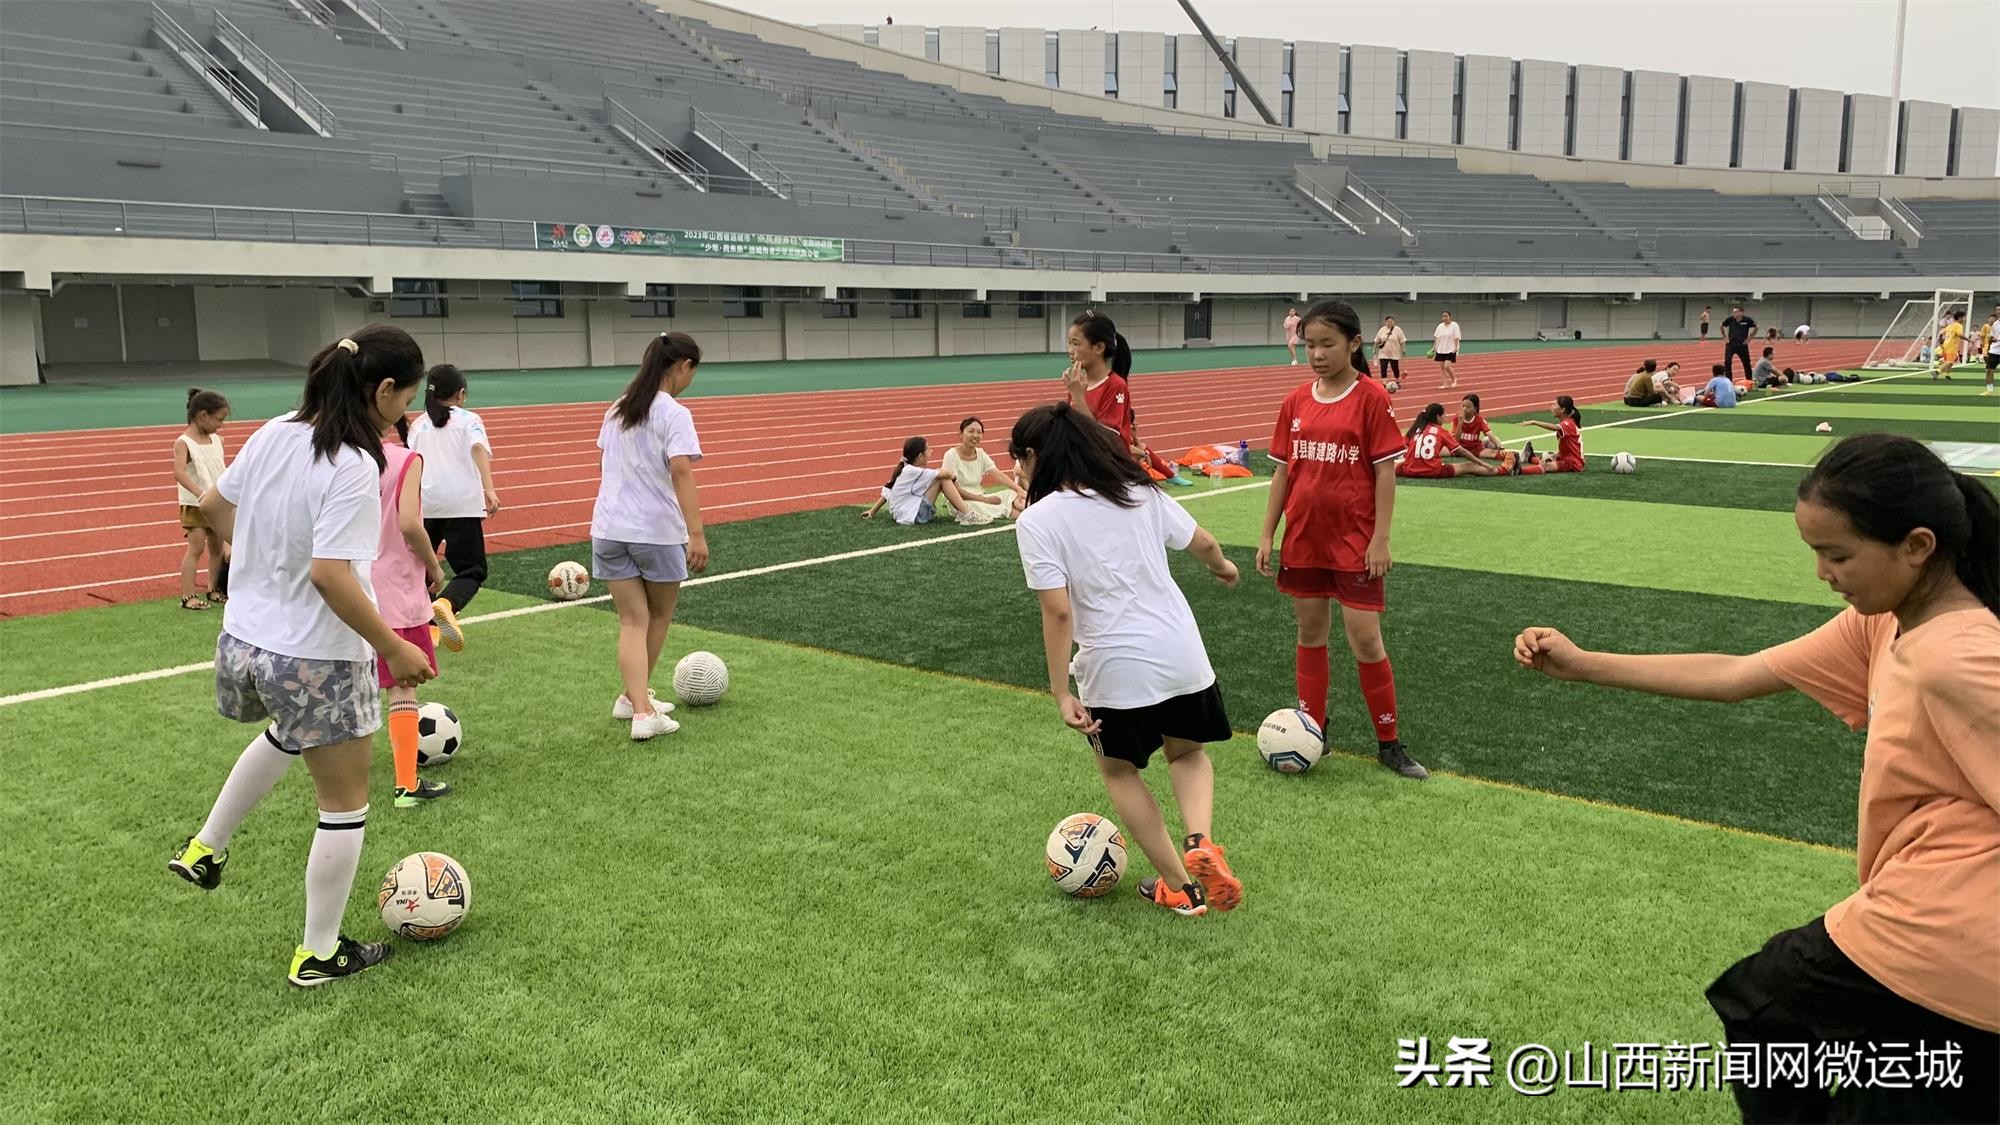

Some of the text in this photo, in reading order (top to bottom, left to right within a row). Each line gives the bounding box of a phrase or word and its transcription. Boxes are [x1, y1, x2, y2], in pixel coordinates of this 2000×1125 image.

[1291, 439, 1360, 465] 夏县新建路小学
[1413, 433, 1437, 460] 18
